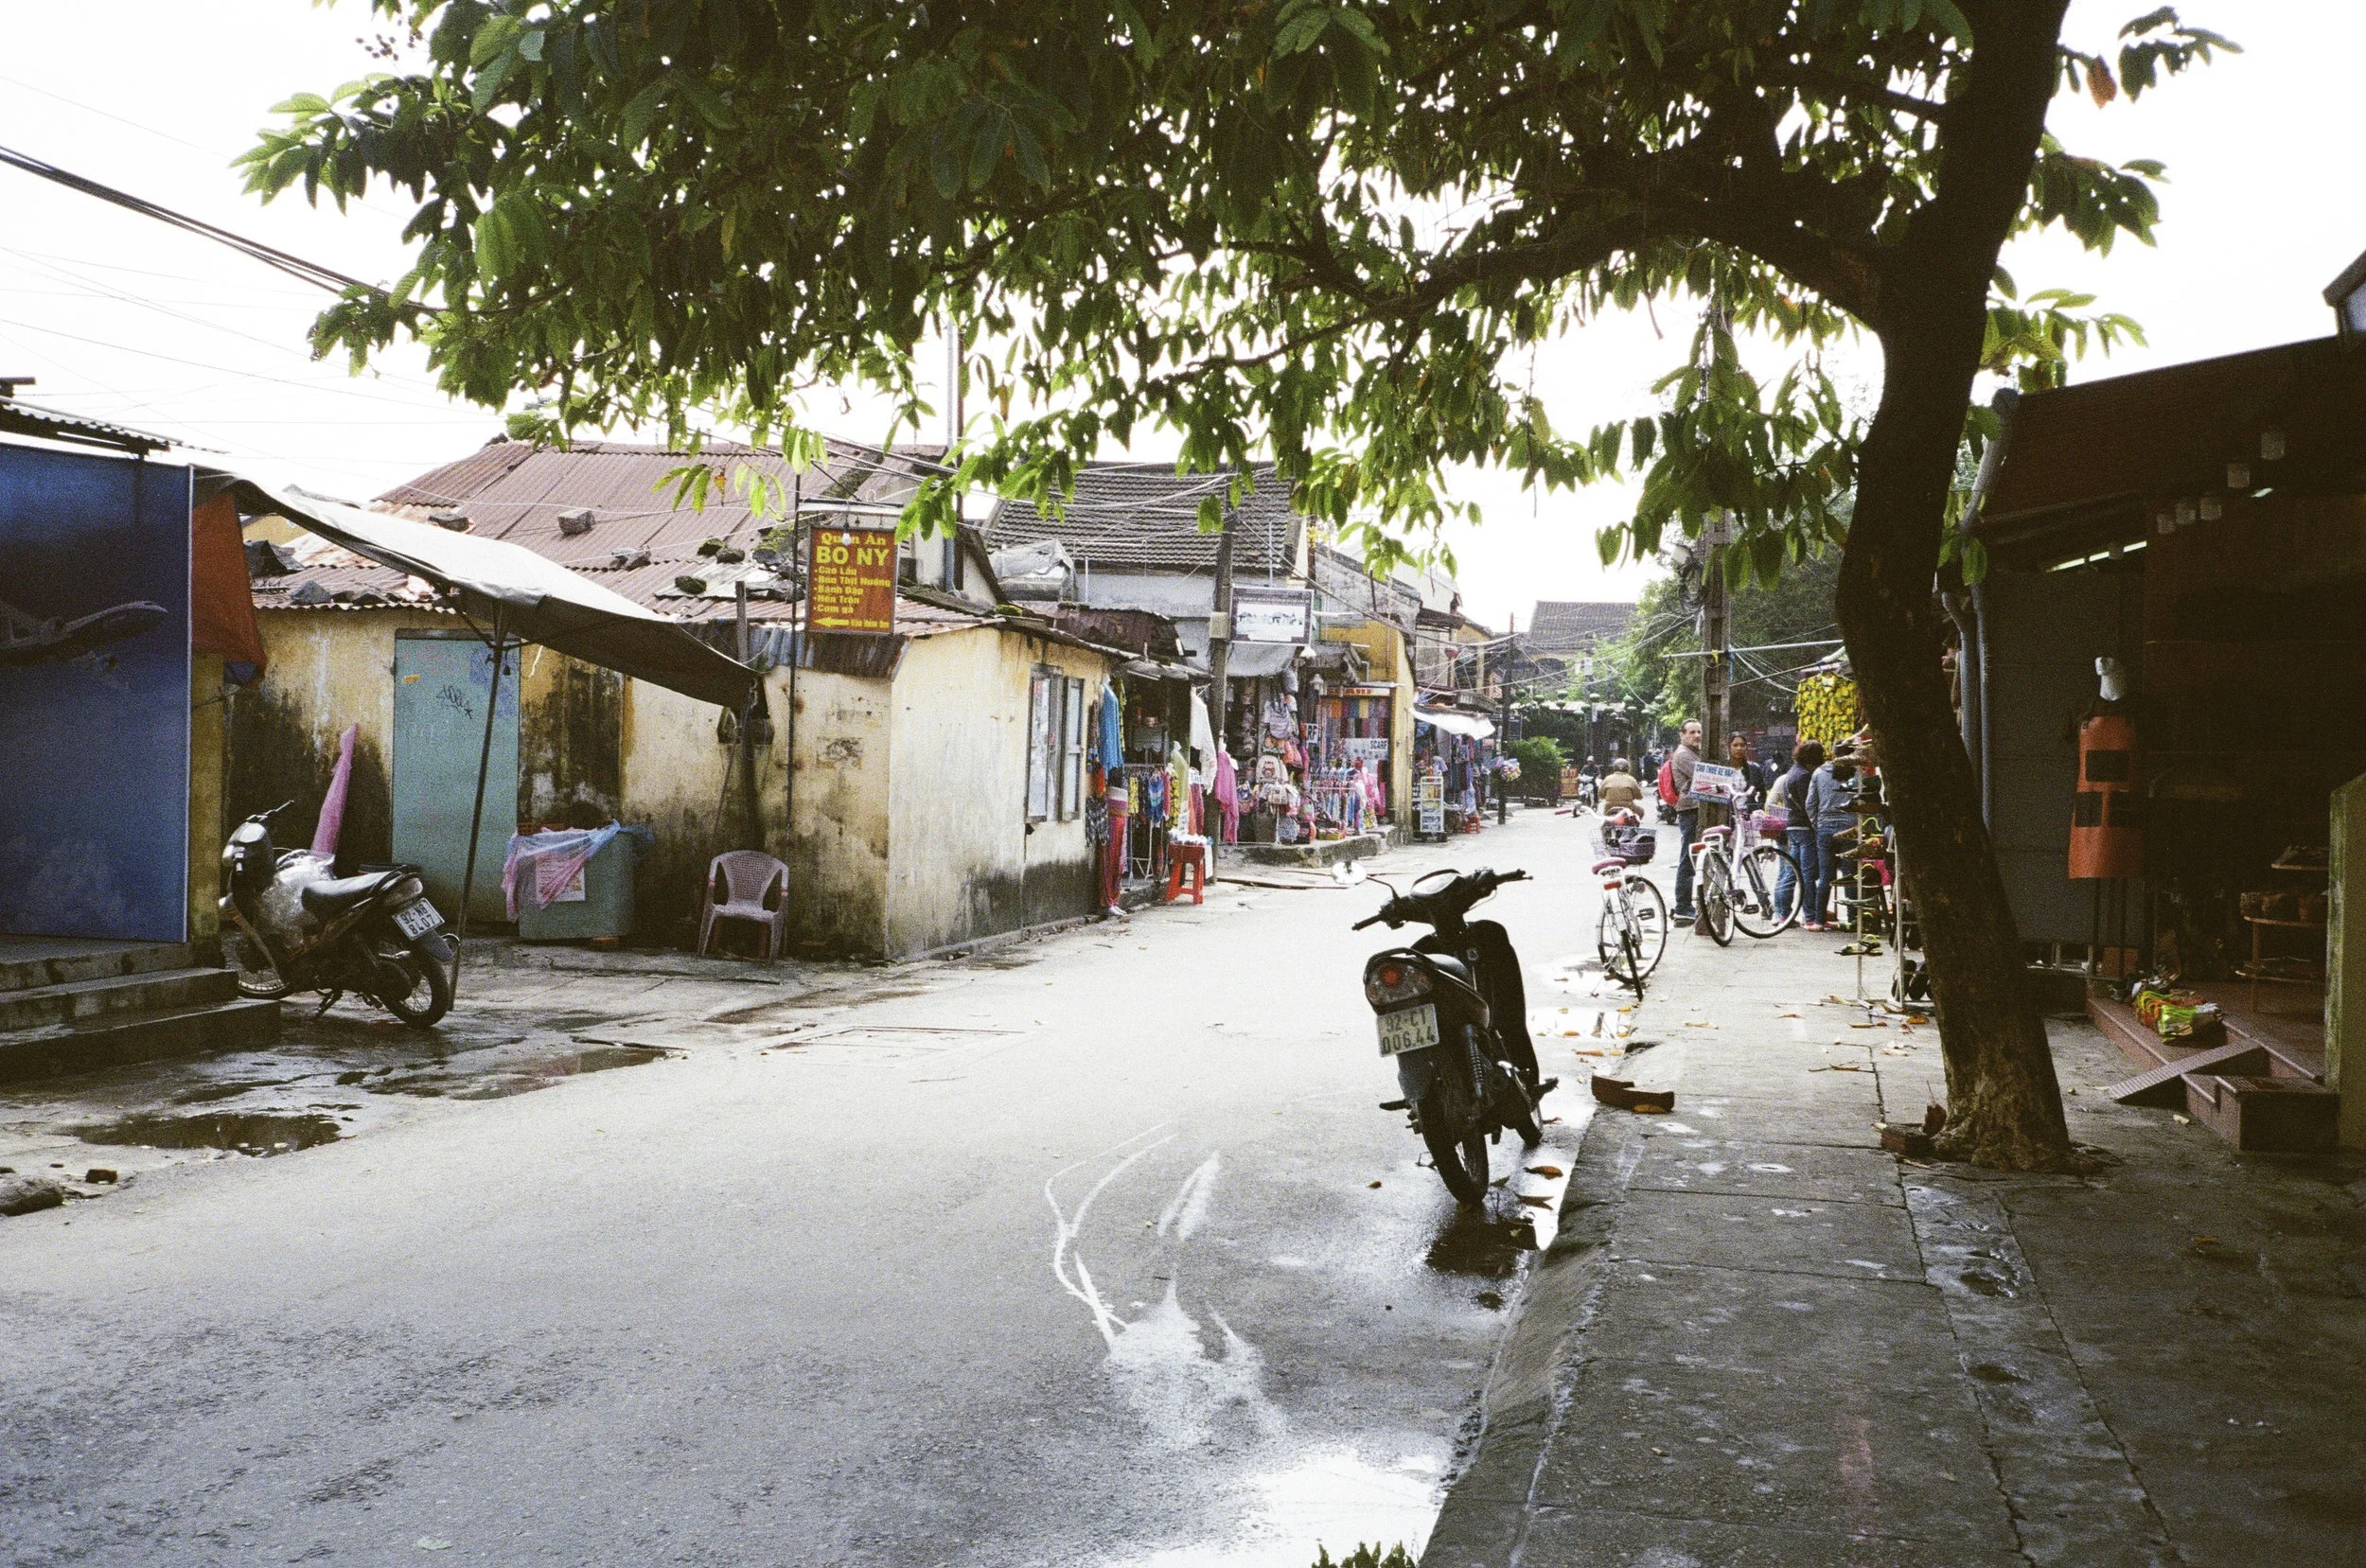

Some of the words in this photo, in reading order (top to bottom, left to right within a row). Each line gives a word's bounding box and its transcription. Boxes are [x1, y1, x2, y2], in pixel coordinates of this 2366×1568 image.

[821, 532, 859, 545] Qun
[817, 546, 849, 565] BO
[856, 548, 890, 566] NY
[819, 566, 838, 574] Cao
[1369, 740, 1387, 749] SCARF
[409, 914, 435, 934] 8407
[1386, 1009, 1426, 1032] 92-C1
[1382, 1026, 1436, 1054] 006.44
